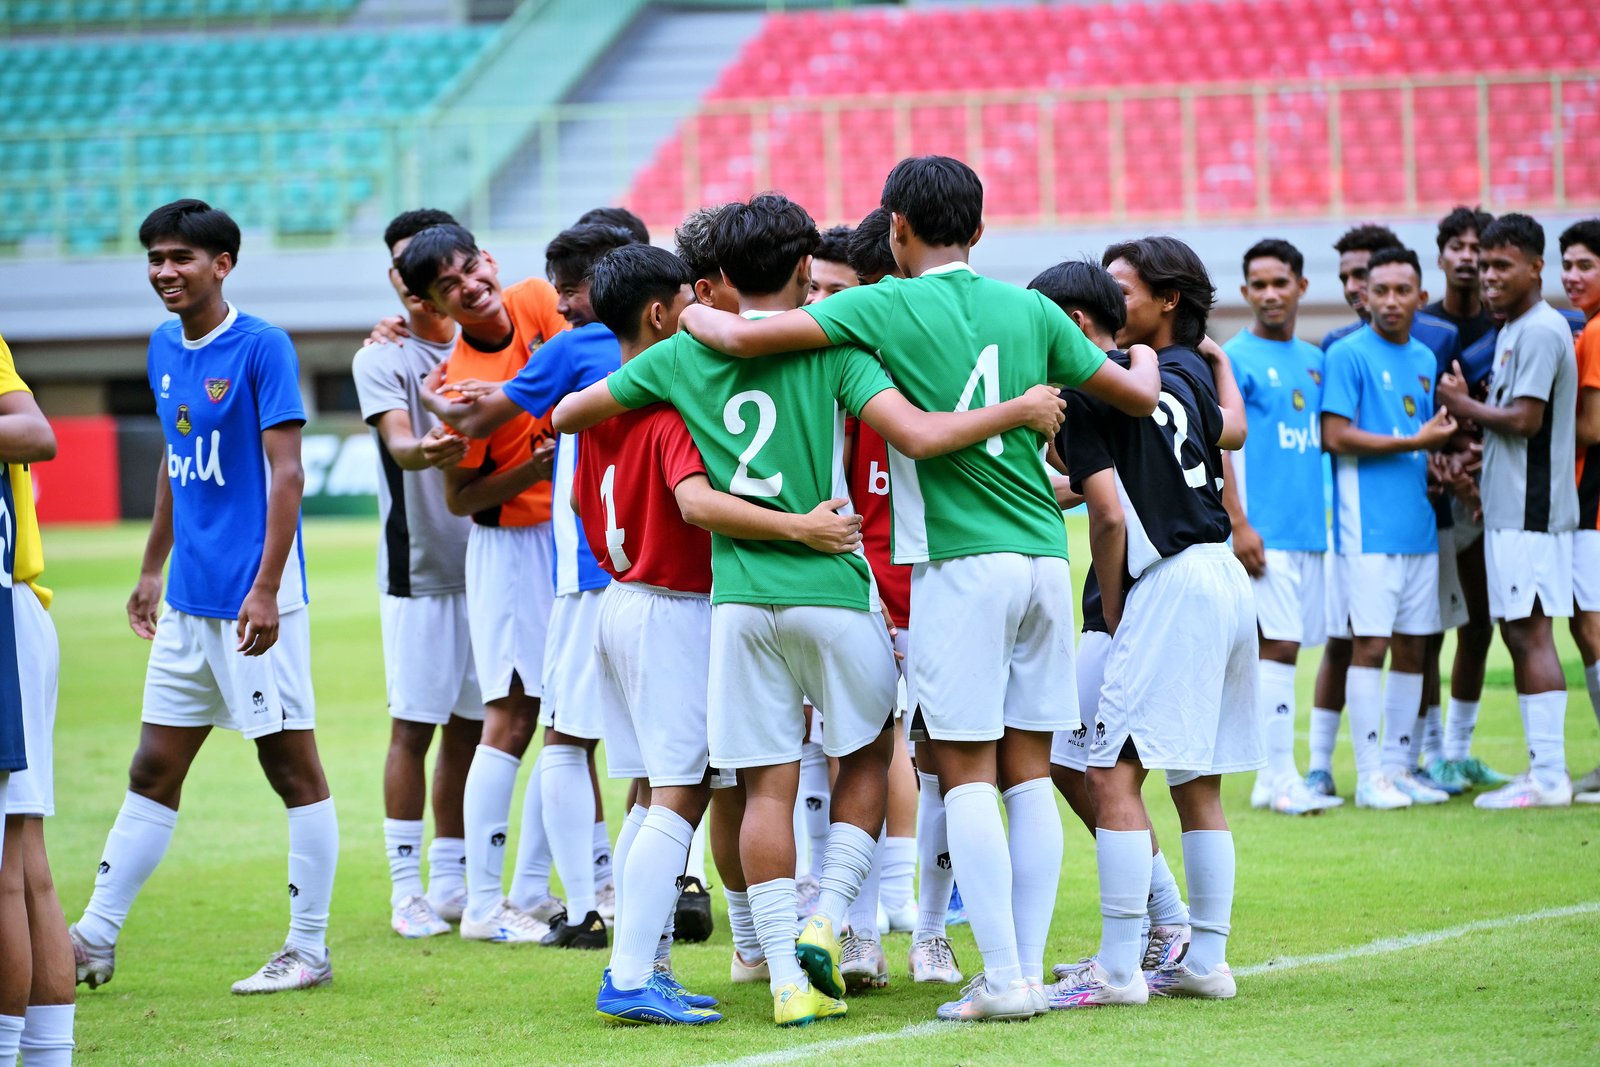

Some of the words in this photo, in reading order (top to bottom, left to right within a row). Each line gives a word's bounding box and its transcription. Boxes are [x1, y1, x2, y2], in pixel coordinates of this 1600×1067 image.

[168, 429, 226, 487] by.U
[723, 389, 783, 497] 2
[1151, 391, 1224, 492] 2
